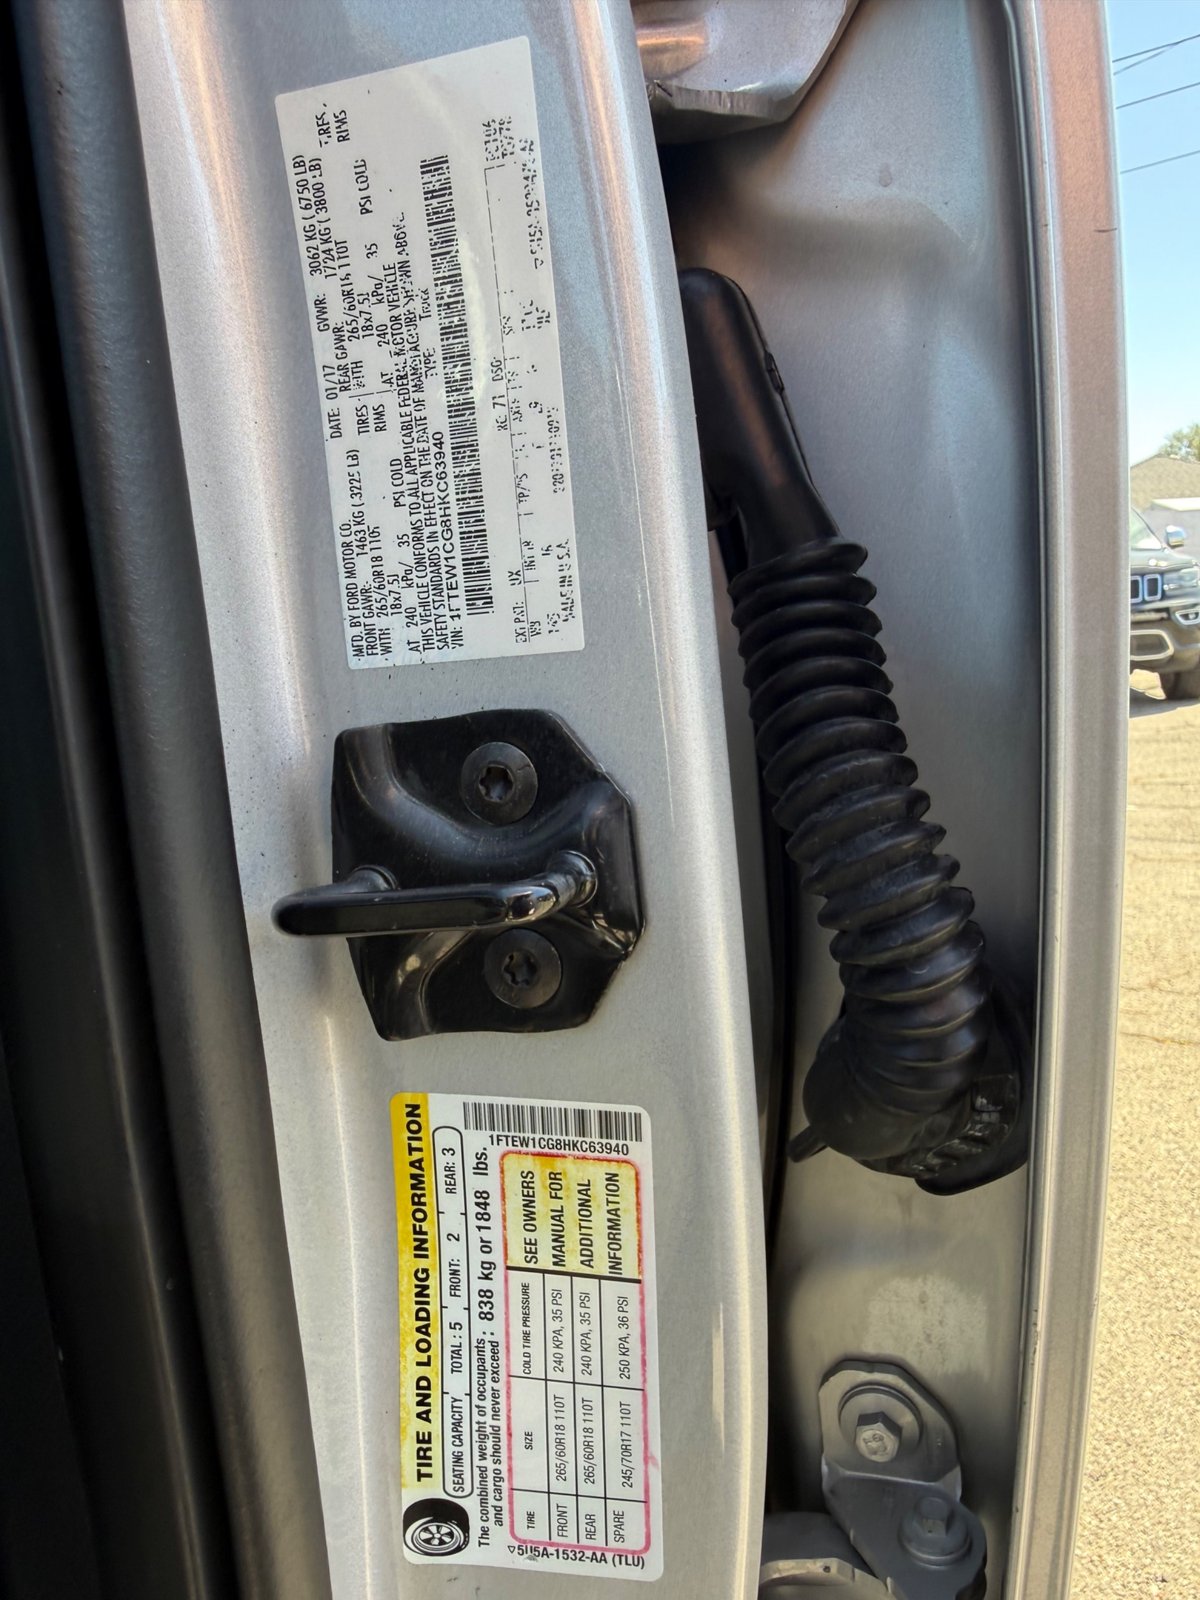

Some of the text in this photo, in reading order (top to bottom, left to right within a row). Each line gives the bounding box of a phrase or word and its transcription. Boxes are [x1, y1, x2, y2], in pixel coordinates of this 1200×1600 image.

[291, 154, 308, 176] LB)
[308, 157, 323, 179] LB)
[302, 223, 318, 242] KG
[317, 227, 333, 246] KG
[332, 109, 375, 340] 18x7.5J RIMS
[305, 244, 323, 277] 3062
[320, 247, 338, 280] 1724
[333, 239, 351, 270] 110T
[353, 158, 395, 386] AT 240 kPa/ 35 PSI COLD
[313, 293, 331, 333] GVWR:
[331, 321, 348, 361] GAWR:
[336, 362, 352, 393] REAR
[321, 364, 343, 439] DATE: 01/17
[412, 397, 426, 412] OF
[491, 394, 507, 410] 71
[413, 415, 430, 444] DATE
[345, 449, 360, 468] LB)
[382, 262, 436, 653] THIS VEHICLE CONFORMS TO ALL APPLICABLE FEDERAL MOTOR VEHICLE
[417, 445, 432, 468] THE
[419, 470, 434, 488] ON
[351, 510, 366, 527] KG
[371, 403, 403, 617] 18x7.5J RIMS
[421, 491, 438, 528] EFFECT
[353, 529, 369, 558] 1463
[354, 404, 393, 656] WITH 265/60R18 110T TIRES
[425, 530, 440, 544] IN
[432, 431, 465, 650] VIN: 1FTEW1CG8HKC63940
[389, 458, 422, 653] AT 240 kPa/ 35 PSI COLD
[338, 519, 365, 658] MFD. BY FORD MOTOR CO.
[426, 546, 446, 611] STANDARDS
[359, 583, 375, 619] GAWR:
[362, 621, 379, 657] FRONT
[433, 613, 450, 651] SAFETY
[472, 1147, 489, 1177] lbs.
[488, 1133, 630, 1156] 1FTEW1CG8HKC63940
[441, 1147, 457, 1195] REAR: 3
[473, 1189, 492, 1233] 1848
[520, 1170, 539, 1265] SEE OWNERS
[548, 1171, 566, 1268] MANUAL FOR
[576, 1178, 594, 1269] ADDITIONAL
[604, 1172, 623, 1276] INFORMATION
[479, 1237, 493, 1255] or
[446, 1232, 462, 1298] FRONT: 2
[477, 1260, 497, 1281] kg
[404, 1103, 433, 1483] TIRE AND LOADING INFORMATION
[477, 1288, 495, 1322] 838
[448, 1321, 463, 1331] 5
[520, 1282, 532, 1375] COLD TIRE PRESSURE
[551, 1288, 565, 1373] 240 KPA, 35 PSI
[578, 1291, 593, 1377] 240 KPA, 35 PSI
[616, 1295, 631, 1380] 250 KPA, 36 PSI
[450, 1396, 465, 1493] SEATING CAPACITY
[473, 1338, 491, 1548] The combined weight of occupants
[487, 1340, 505, 1527] and cargo should never exceed
[524, 1431, 534, 1451] SIZE
[553, 1393, 569, 1482] 265/60R18 110T
[581, 1396, 598, 1485] 265/60R18 110T
[619, 1400, 636, 1489] 245/70R17 110T
[526, 1510, 536, 1530] TIRE
[555, 1503, 569, 1538] FRONT
[584, 1513, 597, 1541] REAR
[612, 1509, 626, 1544] SPARE
[611, 1552, 645, 1570] (TLU)
